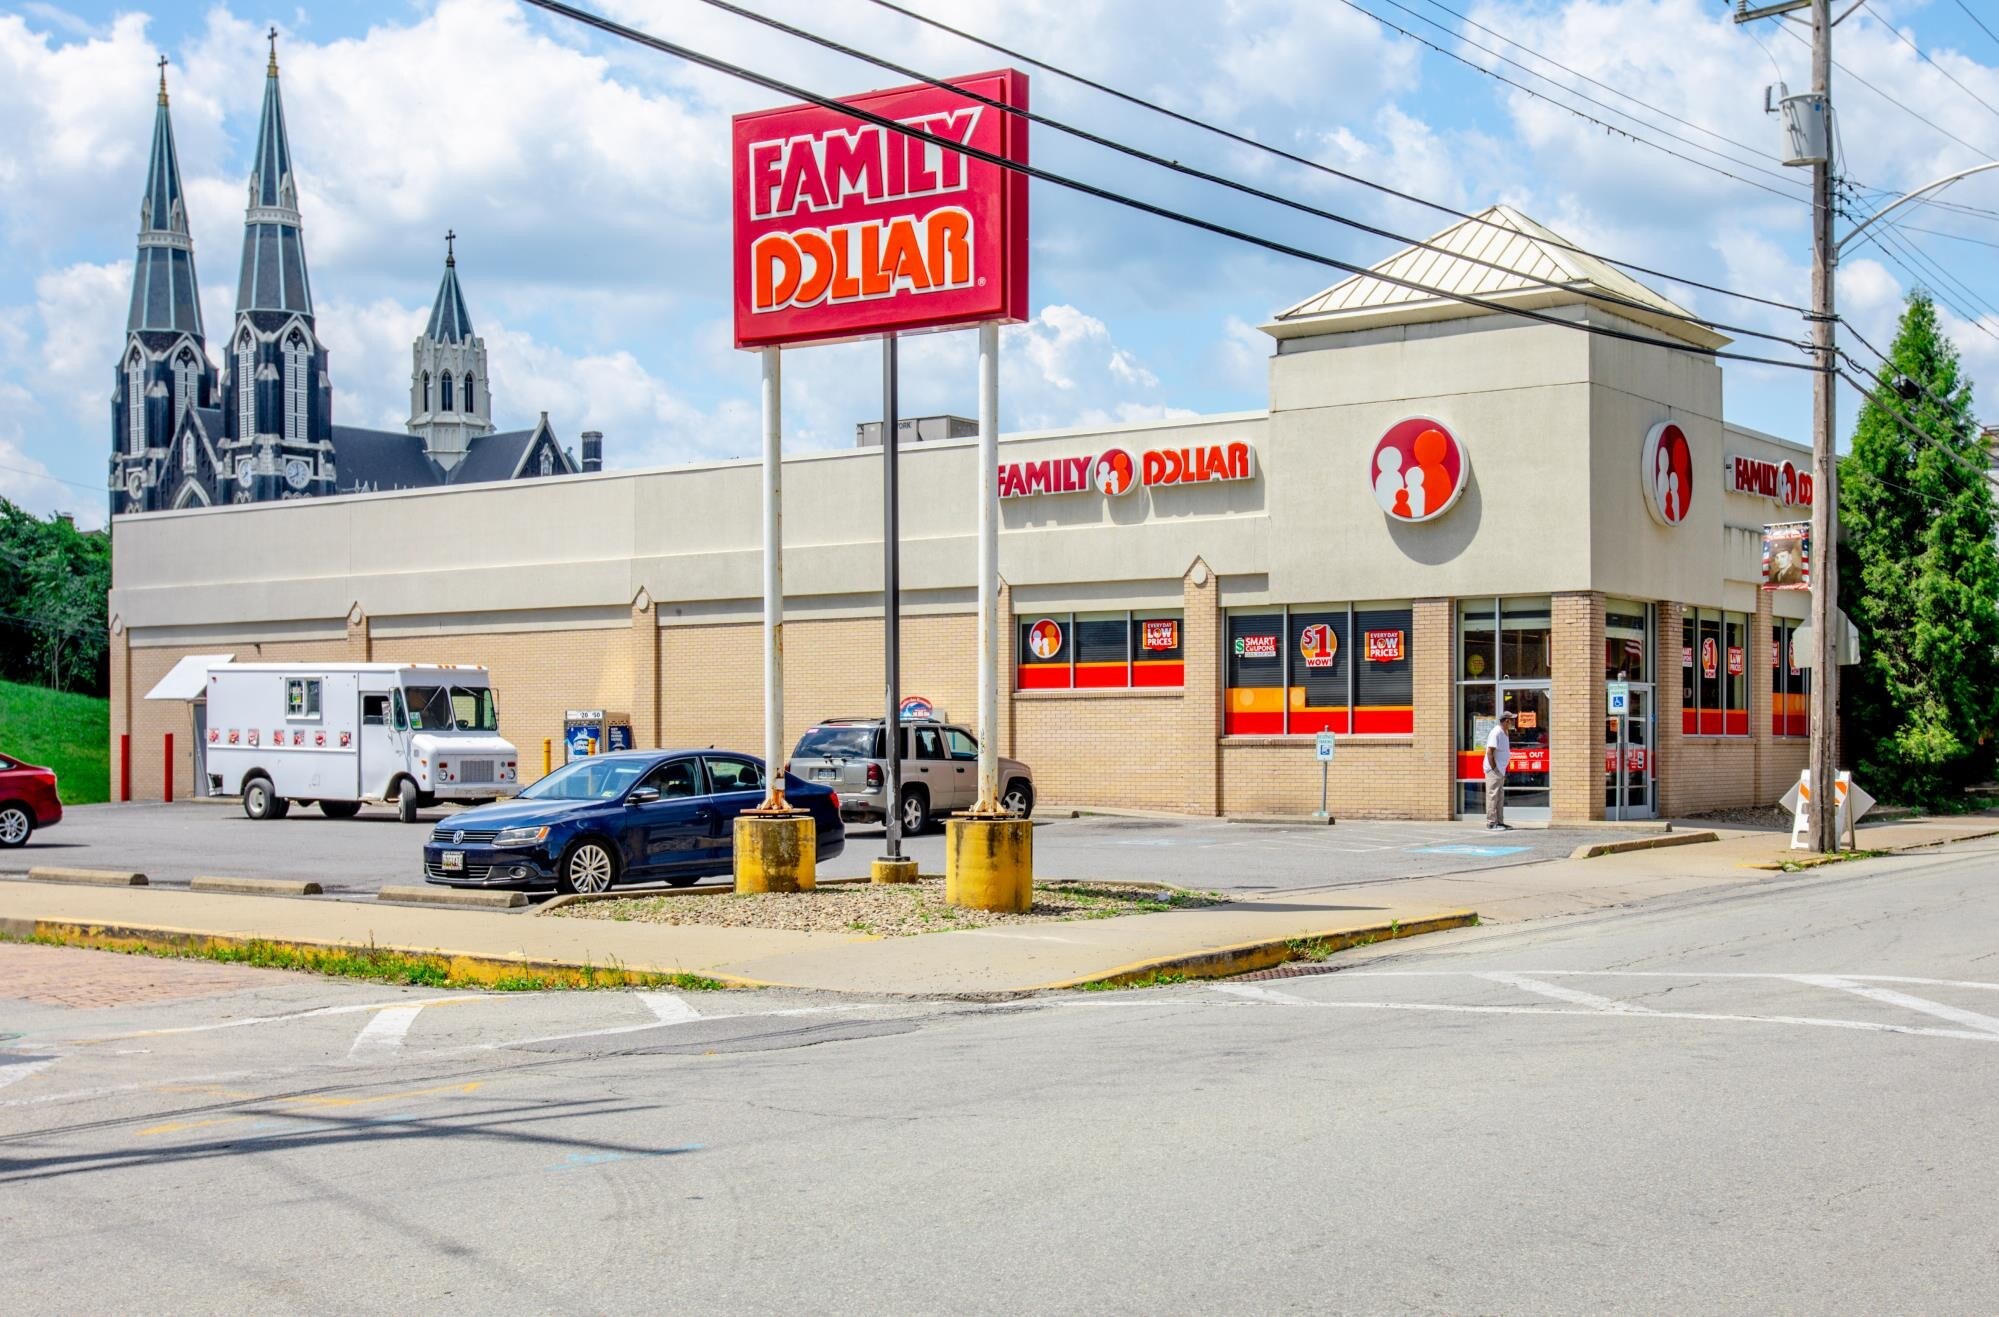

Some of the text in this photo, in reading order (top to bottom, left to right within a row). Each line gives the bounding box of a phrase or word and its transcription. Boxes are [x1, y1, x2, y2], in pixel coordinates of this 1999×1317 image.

[749, 106, 984, 221] FAMILY
[752, 206, 974, 314] DOLLAR
[898, 421, 912, 430] ORK
[998, 441, 1252, 498] FAMILY DOLLAR
[1735, 457, 1779, 497] FAMILY
[1147, 628, 1172, 638] LOW
[1147, 638, 1172, 646] PRICES
[1245, 637, 1275, 646] SMART
[1301, 624, 1331, 658] $1
[1370, 638, 1398, 649] LOW
[1370, 649, 1398, 657] PRICES
[1307, 659, 1332, 667] WOW!
